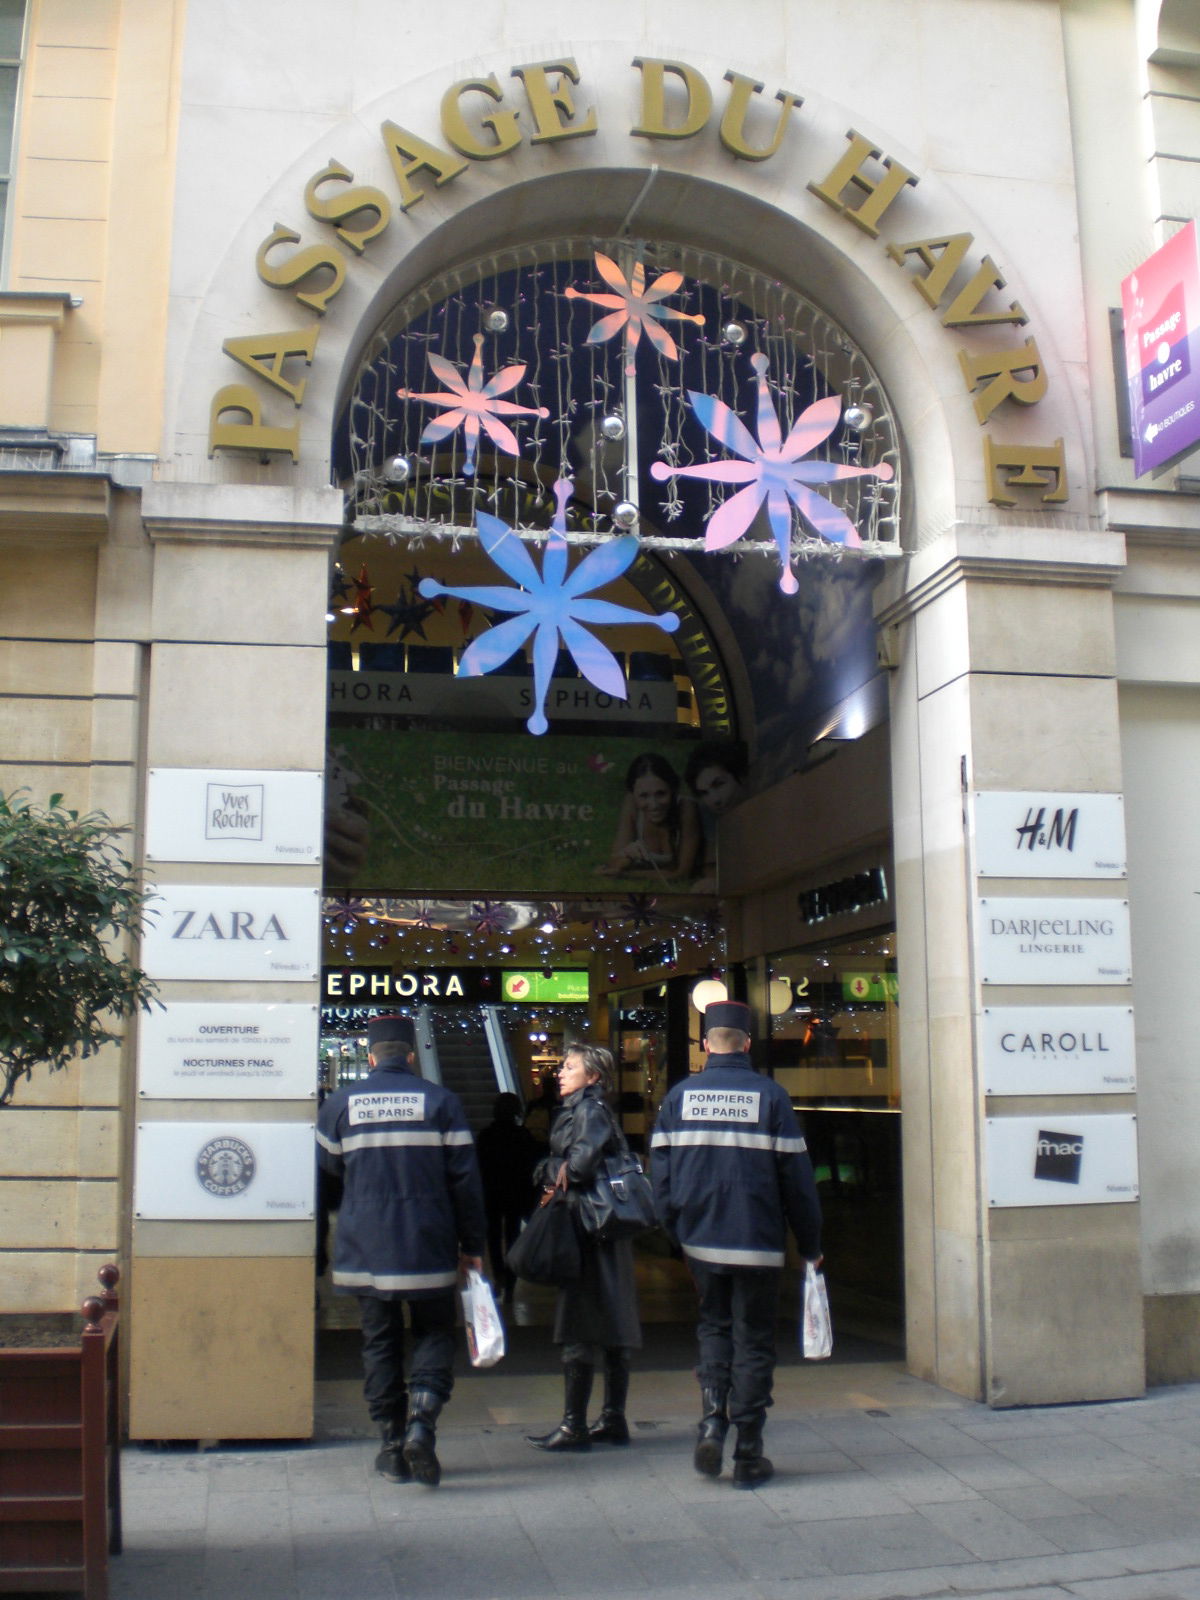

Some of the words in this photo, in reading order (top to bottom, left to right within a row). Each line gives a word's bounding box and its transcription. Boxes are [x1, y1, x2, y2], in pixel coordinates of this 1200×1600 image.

[207, 56, 598, 464] PASSAGE
[630, 54, 804, 161] DU
[806, 128, 1067, 508] HAVRE
[1143, 310, 1182, 347] Passage
[1149, 356, 1183, 391] havre
[519, 688, 653, 711] SPHORA
[433, 754, 548, 774] BIENVENUE
[556, 761, 577, 775] au
[433, 776, 516, 796] Passage
[221, 791, 250, 811] Yves
[446, 796, 486, 820] du
[501, 797, 594, 822] Havre
[212, 808, 259, 830] Rocher
[1015, 807, 1079, 852] H&M
[171, 910, 290, 941] ZARA
[1019, 943, 1085, 954] LINGERIE
[326, 973, 465, 997] EPHORA
[198, 1025, 260, 1035] OUVERTURE
[1001, 1032, 1110, 1053] CAROLL
[182, 1058, 245, 1068] NOCTURNES
[247, 1058, 274, 1068] FNAC
[353, 1095, 418, 1107] POMPIERS
[689, 1094, 754, 1105] POMPIERS
[358, 1110, 374, 1120] DE
[377, 1108, 414, 1119] PARIS
[692, 1107, 709, 1117] DE
[712, 1107, 749, 1118] PARIS
[199, 1139, 253, 1165] STARBUCKS
[1035, 1138, 1084, 1157] fnac
[204, 1178, 246, 1197] COFFEE
